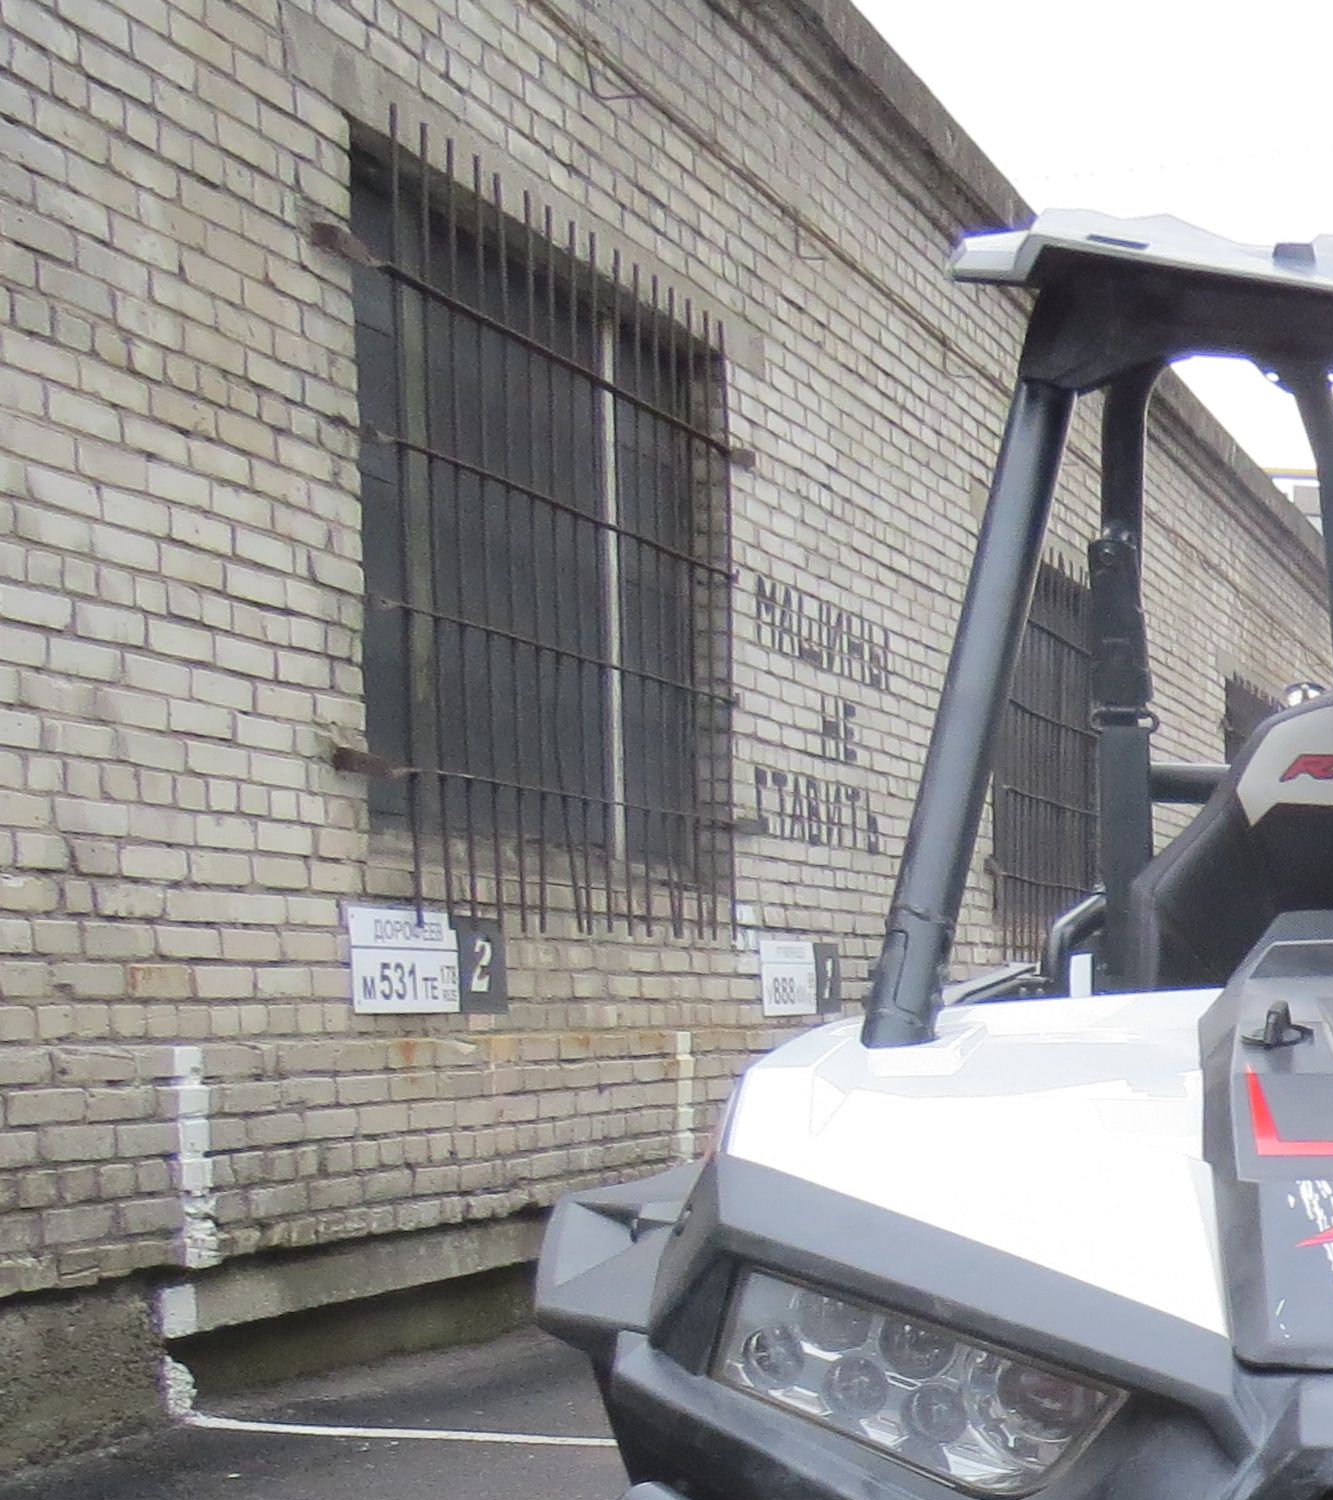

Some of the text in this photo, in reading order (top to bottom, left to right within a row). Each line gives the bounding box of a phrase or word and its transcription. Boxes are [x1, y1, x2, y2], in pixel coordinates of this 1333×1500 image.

[756, 574, 889, 691] МАШИНЫ
[821, 694, 858, 761] НЕ
[755, 766, 879, 855] СТАВИТЬ
[471, 938, 492, 993] 2
